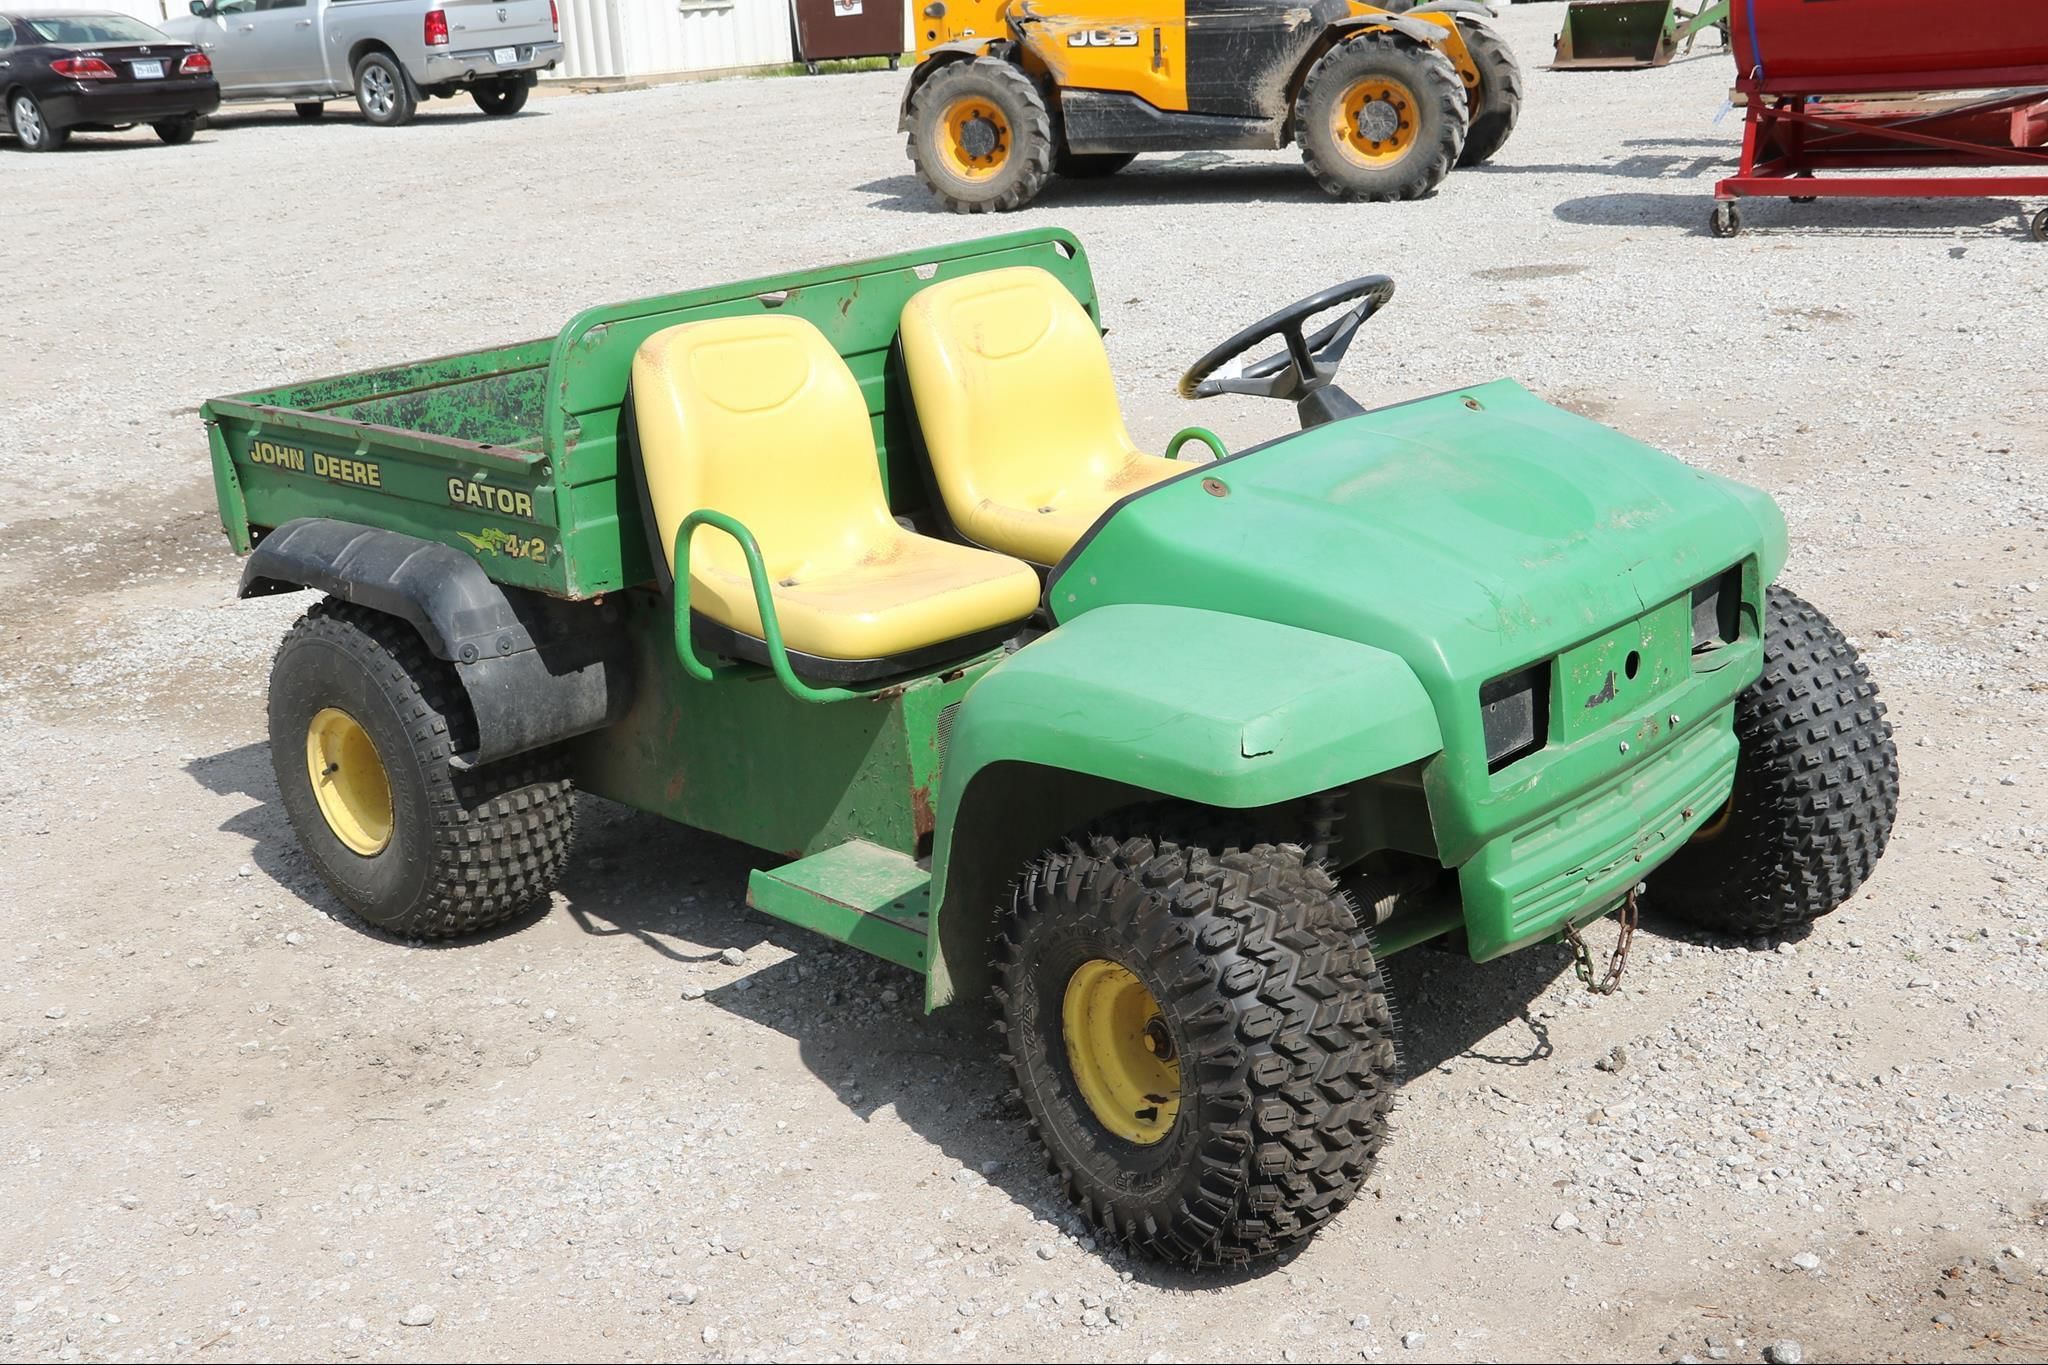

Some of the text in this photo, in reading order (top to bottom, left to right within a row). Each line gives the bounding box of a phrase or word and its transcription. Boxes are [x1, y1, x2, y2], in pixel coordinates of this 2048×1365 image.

[1067, 28, 1139, 47] JCB
[250, 440, 382, 487] JOHN DEERE
[447, 477, 534, 519] GATOR
[503, 533, 547, 564] 4x2
